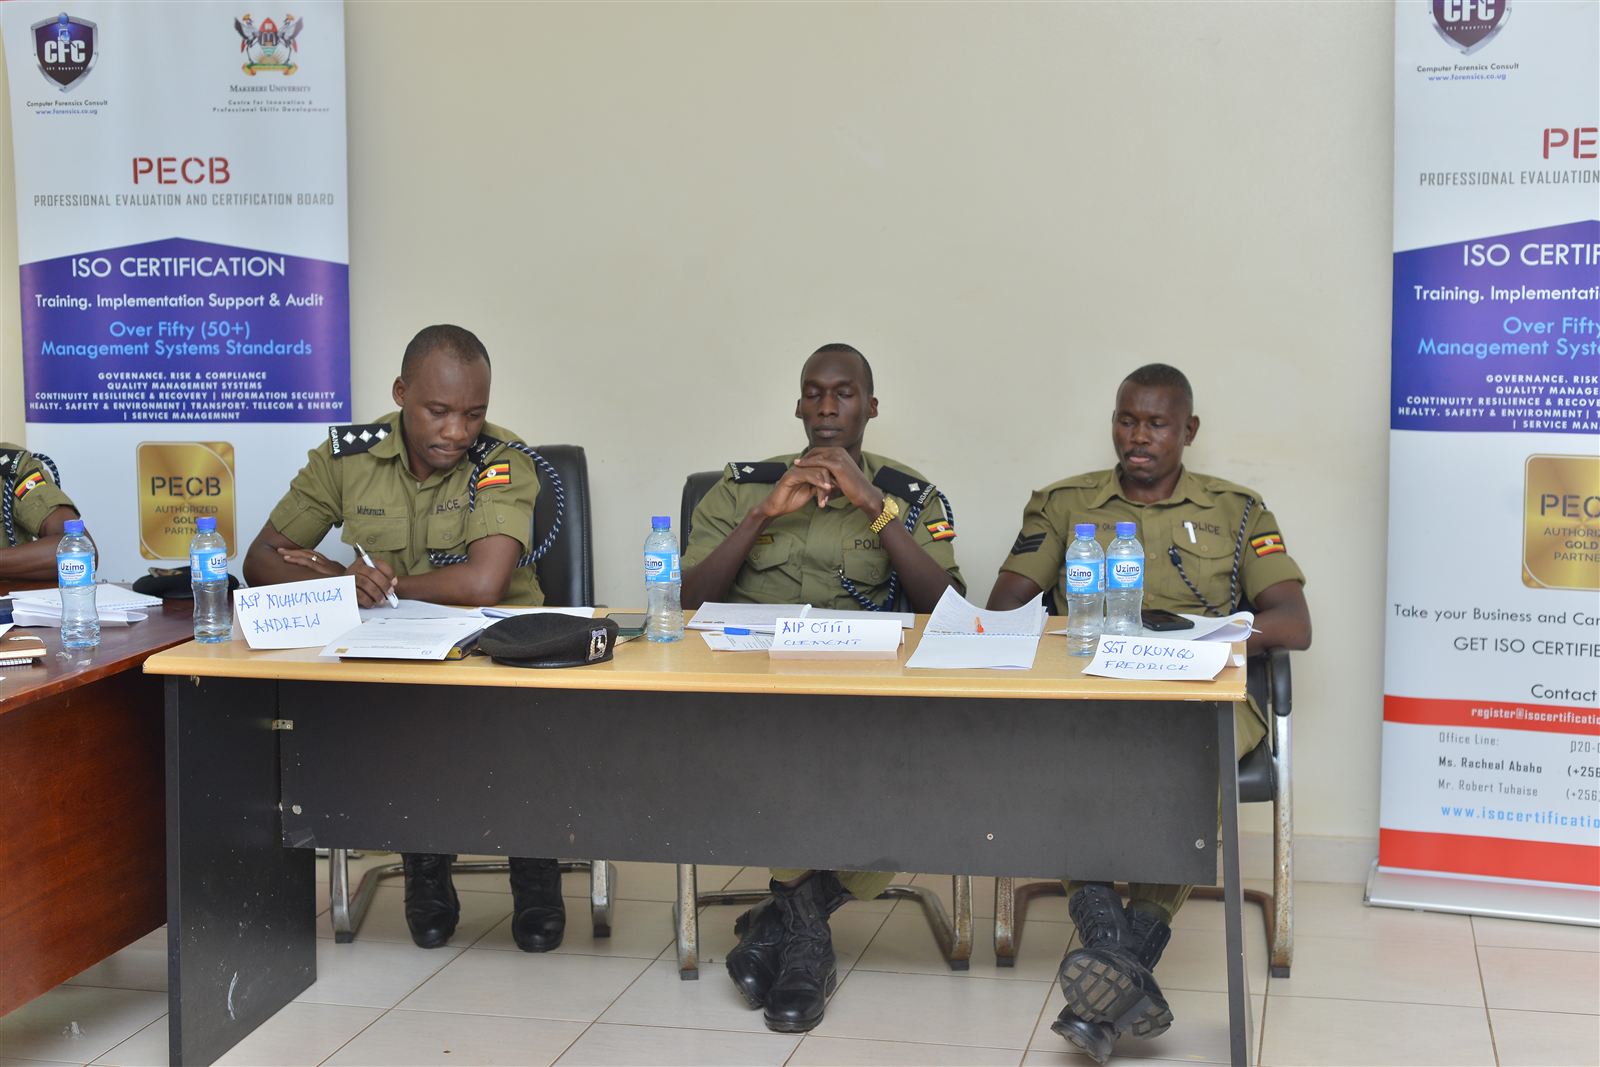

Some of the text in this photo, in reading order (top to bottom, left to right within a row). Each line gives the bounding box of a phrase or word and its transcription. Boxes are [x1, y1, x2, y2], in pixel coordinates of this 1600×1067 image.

[1443, 0, 1495, 22] CFC
[44, 40, 86, 63] CFC
[1416, 65, 1452, 73] Computer
[1490, 62, 1519, 70] Consult
[1428, 73, 1507, 81] www.forensics.co.ug
[1542, 127, 1599, 160] PE
[132, 157, 231, 184] PECB
[1419, 170, 1600, 186] PROFESSIONAL EVALUATION
[33, 193, 335, 207] PROFESSIONAL EVALUATION AND CERTIFICATION BOARD
[1463, 243, 1600, 267] ISO CERTIF
[72, 256, 286, 278] ISO CERTIFICATION
[97, 293, 204, 310] Implementation
[208, 293, 264, 310] Support
[269, 293, 280, 306] &
[285, 292, 324, 306] Audit
[1490, 285, 1600, 304] Implementati
[109, 321, 250, 340] Over Fifty (50+)
[1503, 316, 1600, 338] Over Fifty
[41, 339, 312, 359] Management Systems Standards
[1417, 338, 1549, 359] Management
[170, 372, 191, 380] RISK
[195, 372, 202, 380] &
[205, 371, 267, 380] COMPLIANCE
[1573, 375, 1599, 384] RISK
[107, 382, 262, 390] QUALITY MANAGEMENT SYSTEMS
[1496, 386, 1599, 396] QUALITY MANAGE
[35, 392, 88, 400] CONTINUITY
[92, 392, 146, 400] RESILIENCE
[149, 392, 155, 400] &
[158, 392, 207, 400] RECOVERY
[221, 392, 288, 400] INFORMATION
[291, 391, 336, 400] SECURITY
[1406, 396, 1473, 405] CONTINUITY
[1478, 397, 1540, 406] RESILIENCE
[1545, 397, 1552, 406] &
[65, 402, 99, 410] SAFETY
[103, 402, 109, 410] &
[113, 402, 180, 410] ENVIRONMENT
[252, 401, 294, 410] TELECOM
[297, 401, 304, 410] &
[307, 401, 343, 410] ENERGY
[1445, 408, 1485, 417] SAFETY
[1489, 408, 1496, 417] &
[1501, 408, 1582, 418] ENVIRONMENT
[132, 412, 168, 420] SERVICE
[1523, 420, 1568, 429] SERVICE
[1572, 421, 1600, 430] MAN
[151, 476, 221, 496] PECB
[155, 505, 218, 514] AUTHORIZED
[1564, 540, 1599, 550] GOLD
[60, 563, 85, 571] Uzima
[1068, 568, 1092, 577] Uzima
[1115, 564, 1140, 573] Uzima
[238, 592, 260, 611] ASP
[1394, 604, 1428, 619] Take
[1434, 609, 1467, 622] your
[1473, 607, 1532, 622] Business
[1537, 612, 1567, 625] and
[253, 613, 321, 634] ANDREW
[782, 621, 805, 634] AIP
[1102, 640, 1127, 654] SGT
[1453, 636, 1600, 658] GET ISO CERTIFIE
[1530, 684, 1598, 702] Contact
[1439, 731, 1470, 744] Office
[1474, 733, 1499, 746] Line:
[1438, 756, 1456, 767] Ms.
[1461, 757, 1504, 770] Racheal
[1509, 760, 1542, 774] Abaho
[1438, 779, 1600, 802] Mr. Robert Tuhaise (+256
